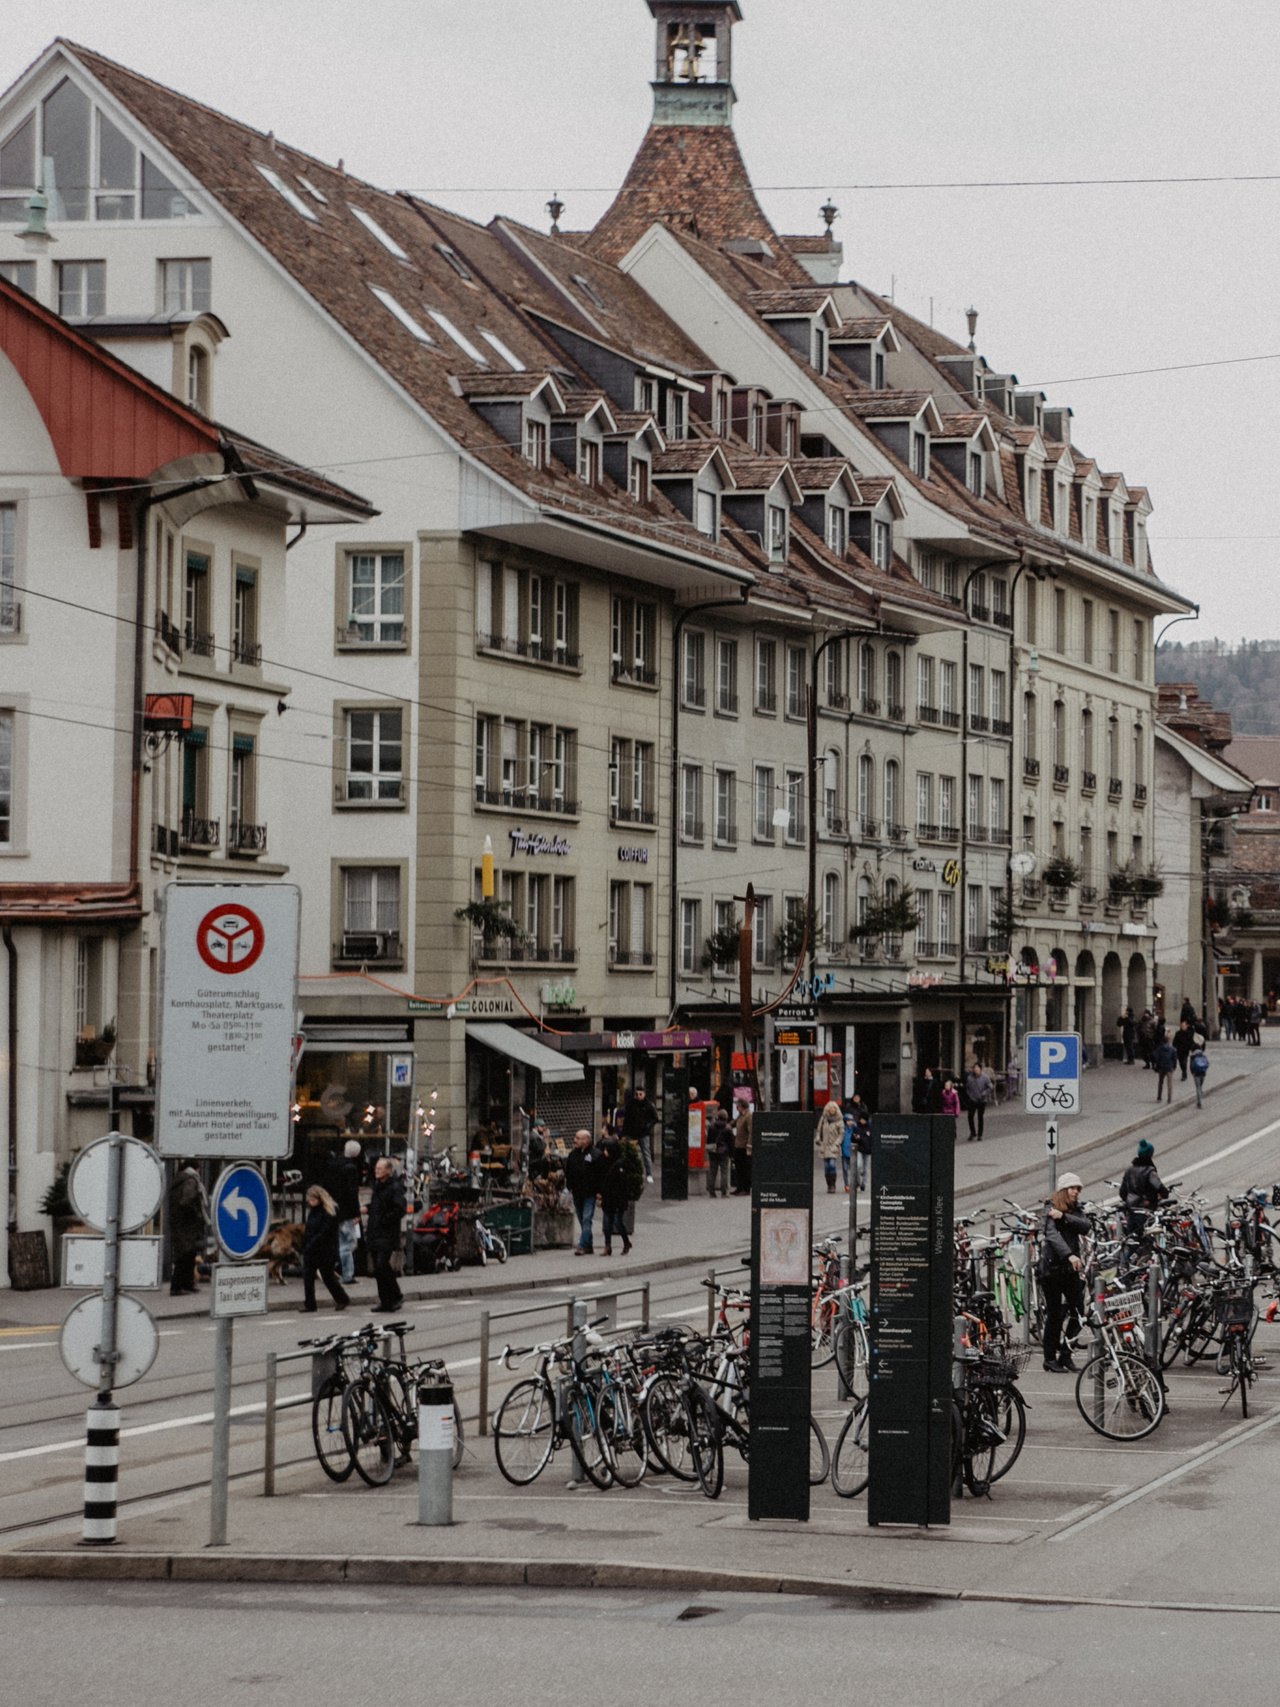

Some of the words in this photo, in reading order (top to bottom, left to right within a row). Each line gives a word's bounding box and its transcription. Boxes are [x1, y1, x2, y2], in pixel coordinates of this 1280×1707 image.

[197, 989, 260, 1000] Güterumschlag
[471, 1000, 513, 1013] COLONIAL
[779, 1008, 806, 1016] Perron
[202, 1011, 254, 1020] Theaterplatz
[617, 1032, 635, 1048] kiosk
[207, 1043, 246, 1053] gestattet
[1040, 1042, 1067, 1075] P
[178, 1120, 208, 1129] Zufahrt
[211, 1121, 233, 1129] Hotel
[236, 1121, 251, 1129] und
[254, 1121, 270, 1130] Taxi
[205, 1132, 242, 1141] gestattet
[935, 1195, 944, 1215] Klee
[936, 1217, 943, 1227] zu
[935, 1233, 945, 1255] Wege
[218, 1276, 264, 1288] ausgenommen
[220, 1290, 233, 1302] Taxi
[234, 1289, 247, 1301] und
